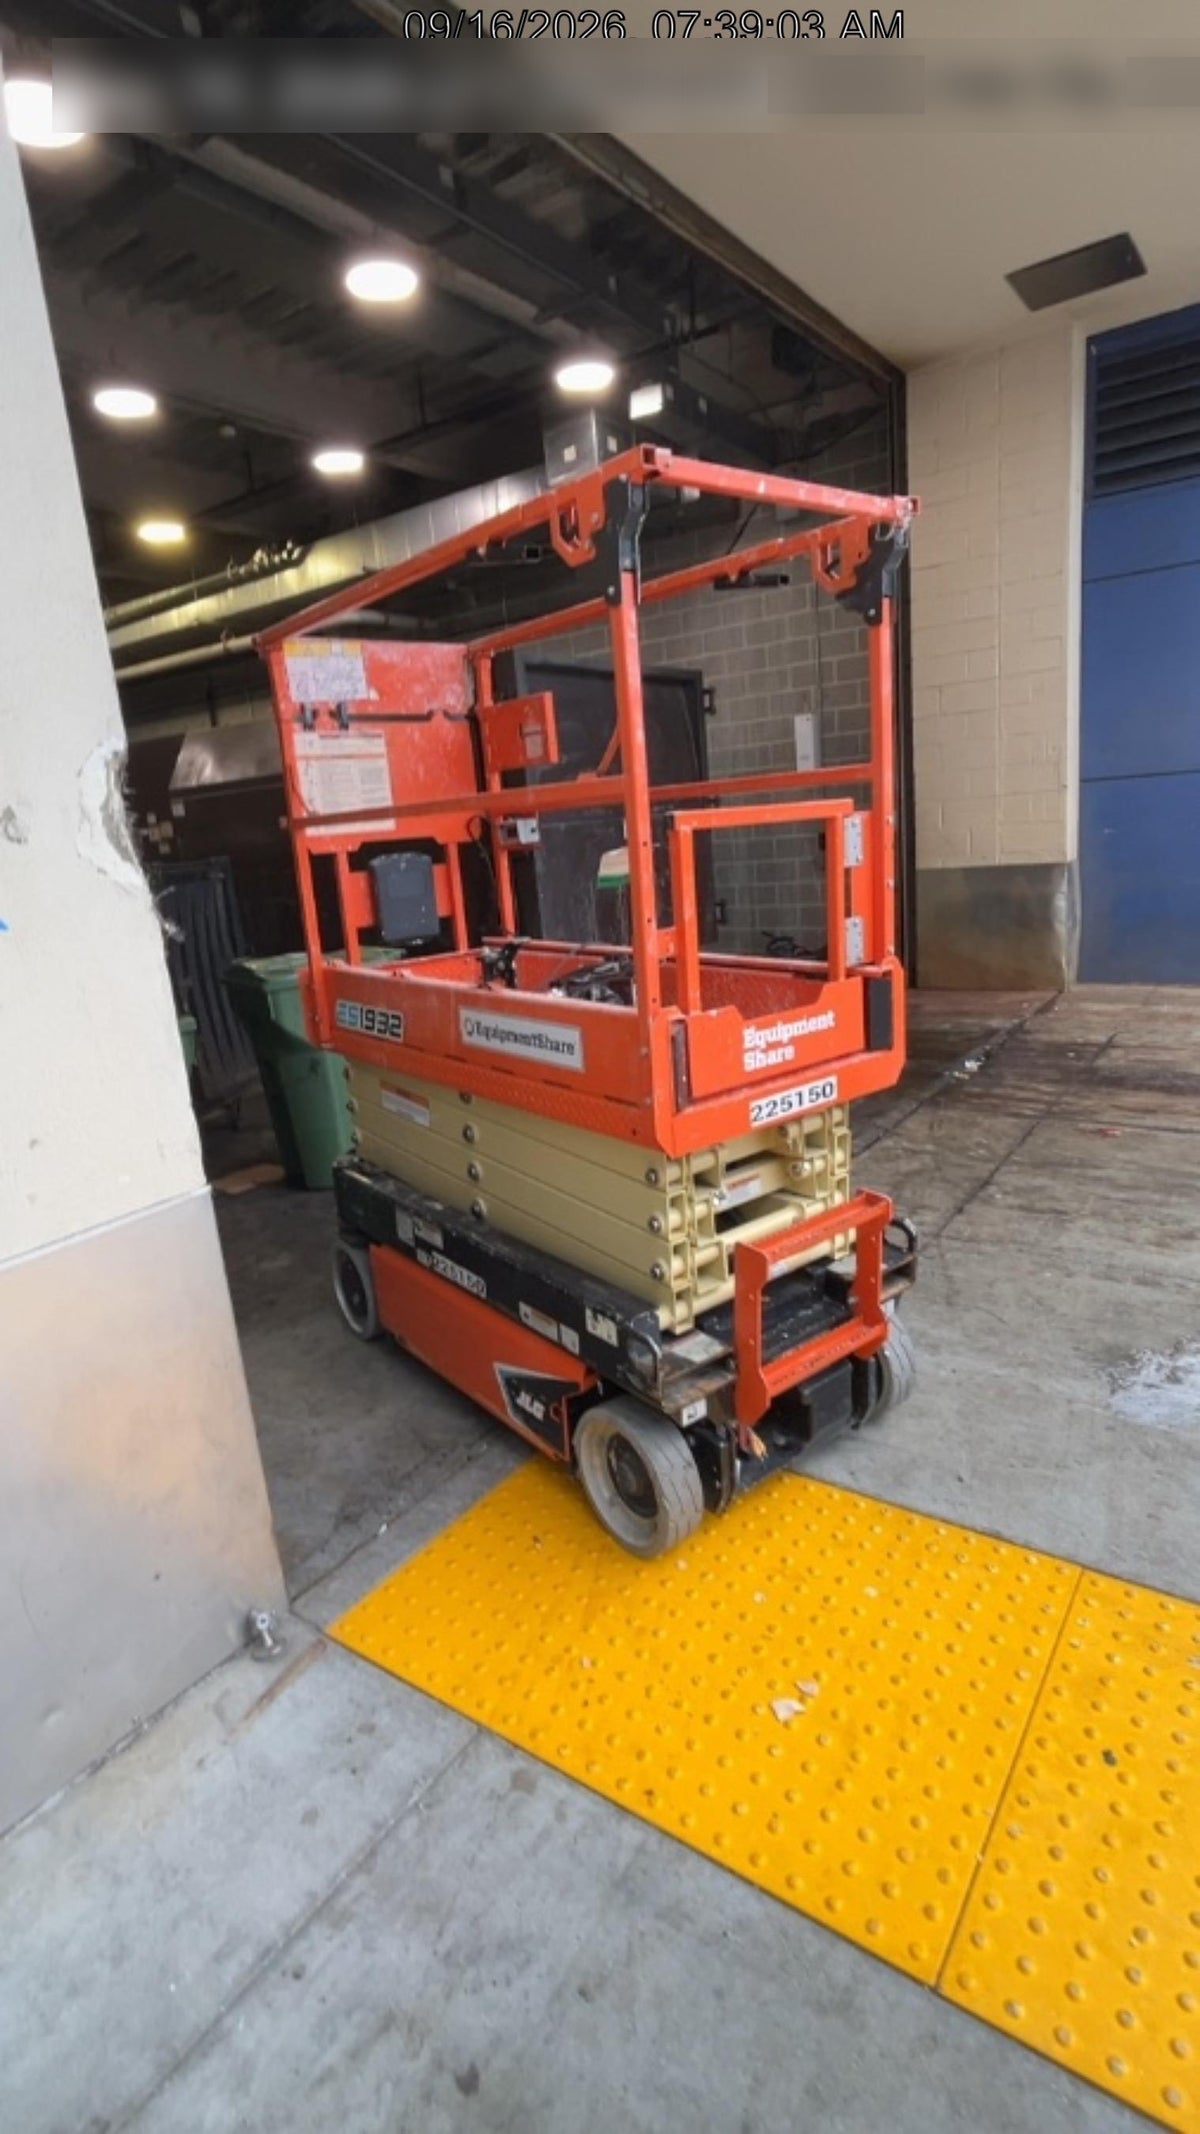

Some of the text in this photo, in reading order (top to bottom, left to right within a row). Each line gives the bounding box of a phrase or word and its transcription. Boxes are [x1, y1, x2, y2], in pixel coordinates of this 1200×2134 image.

[338, 1002, 402, 1037] ES1932
[743, 1010, 835, 1049] Equipment
[475, 1021, 575, 1055] EquipmentShare
[743, 1045, 795, 1072] Share
[751, 1081, 834, 1122] 225150
